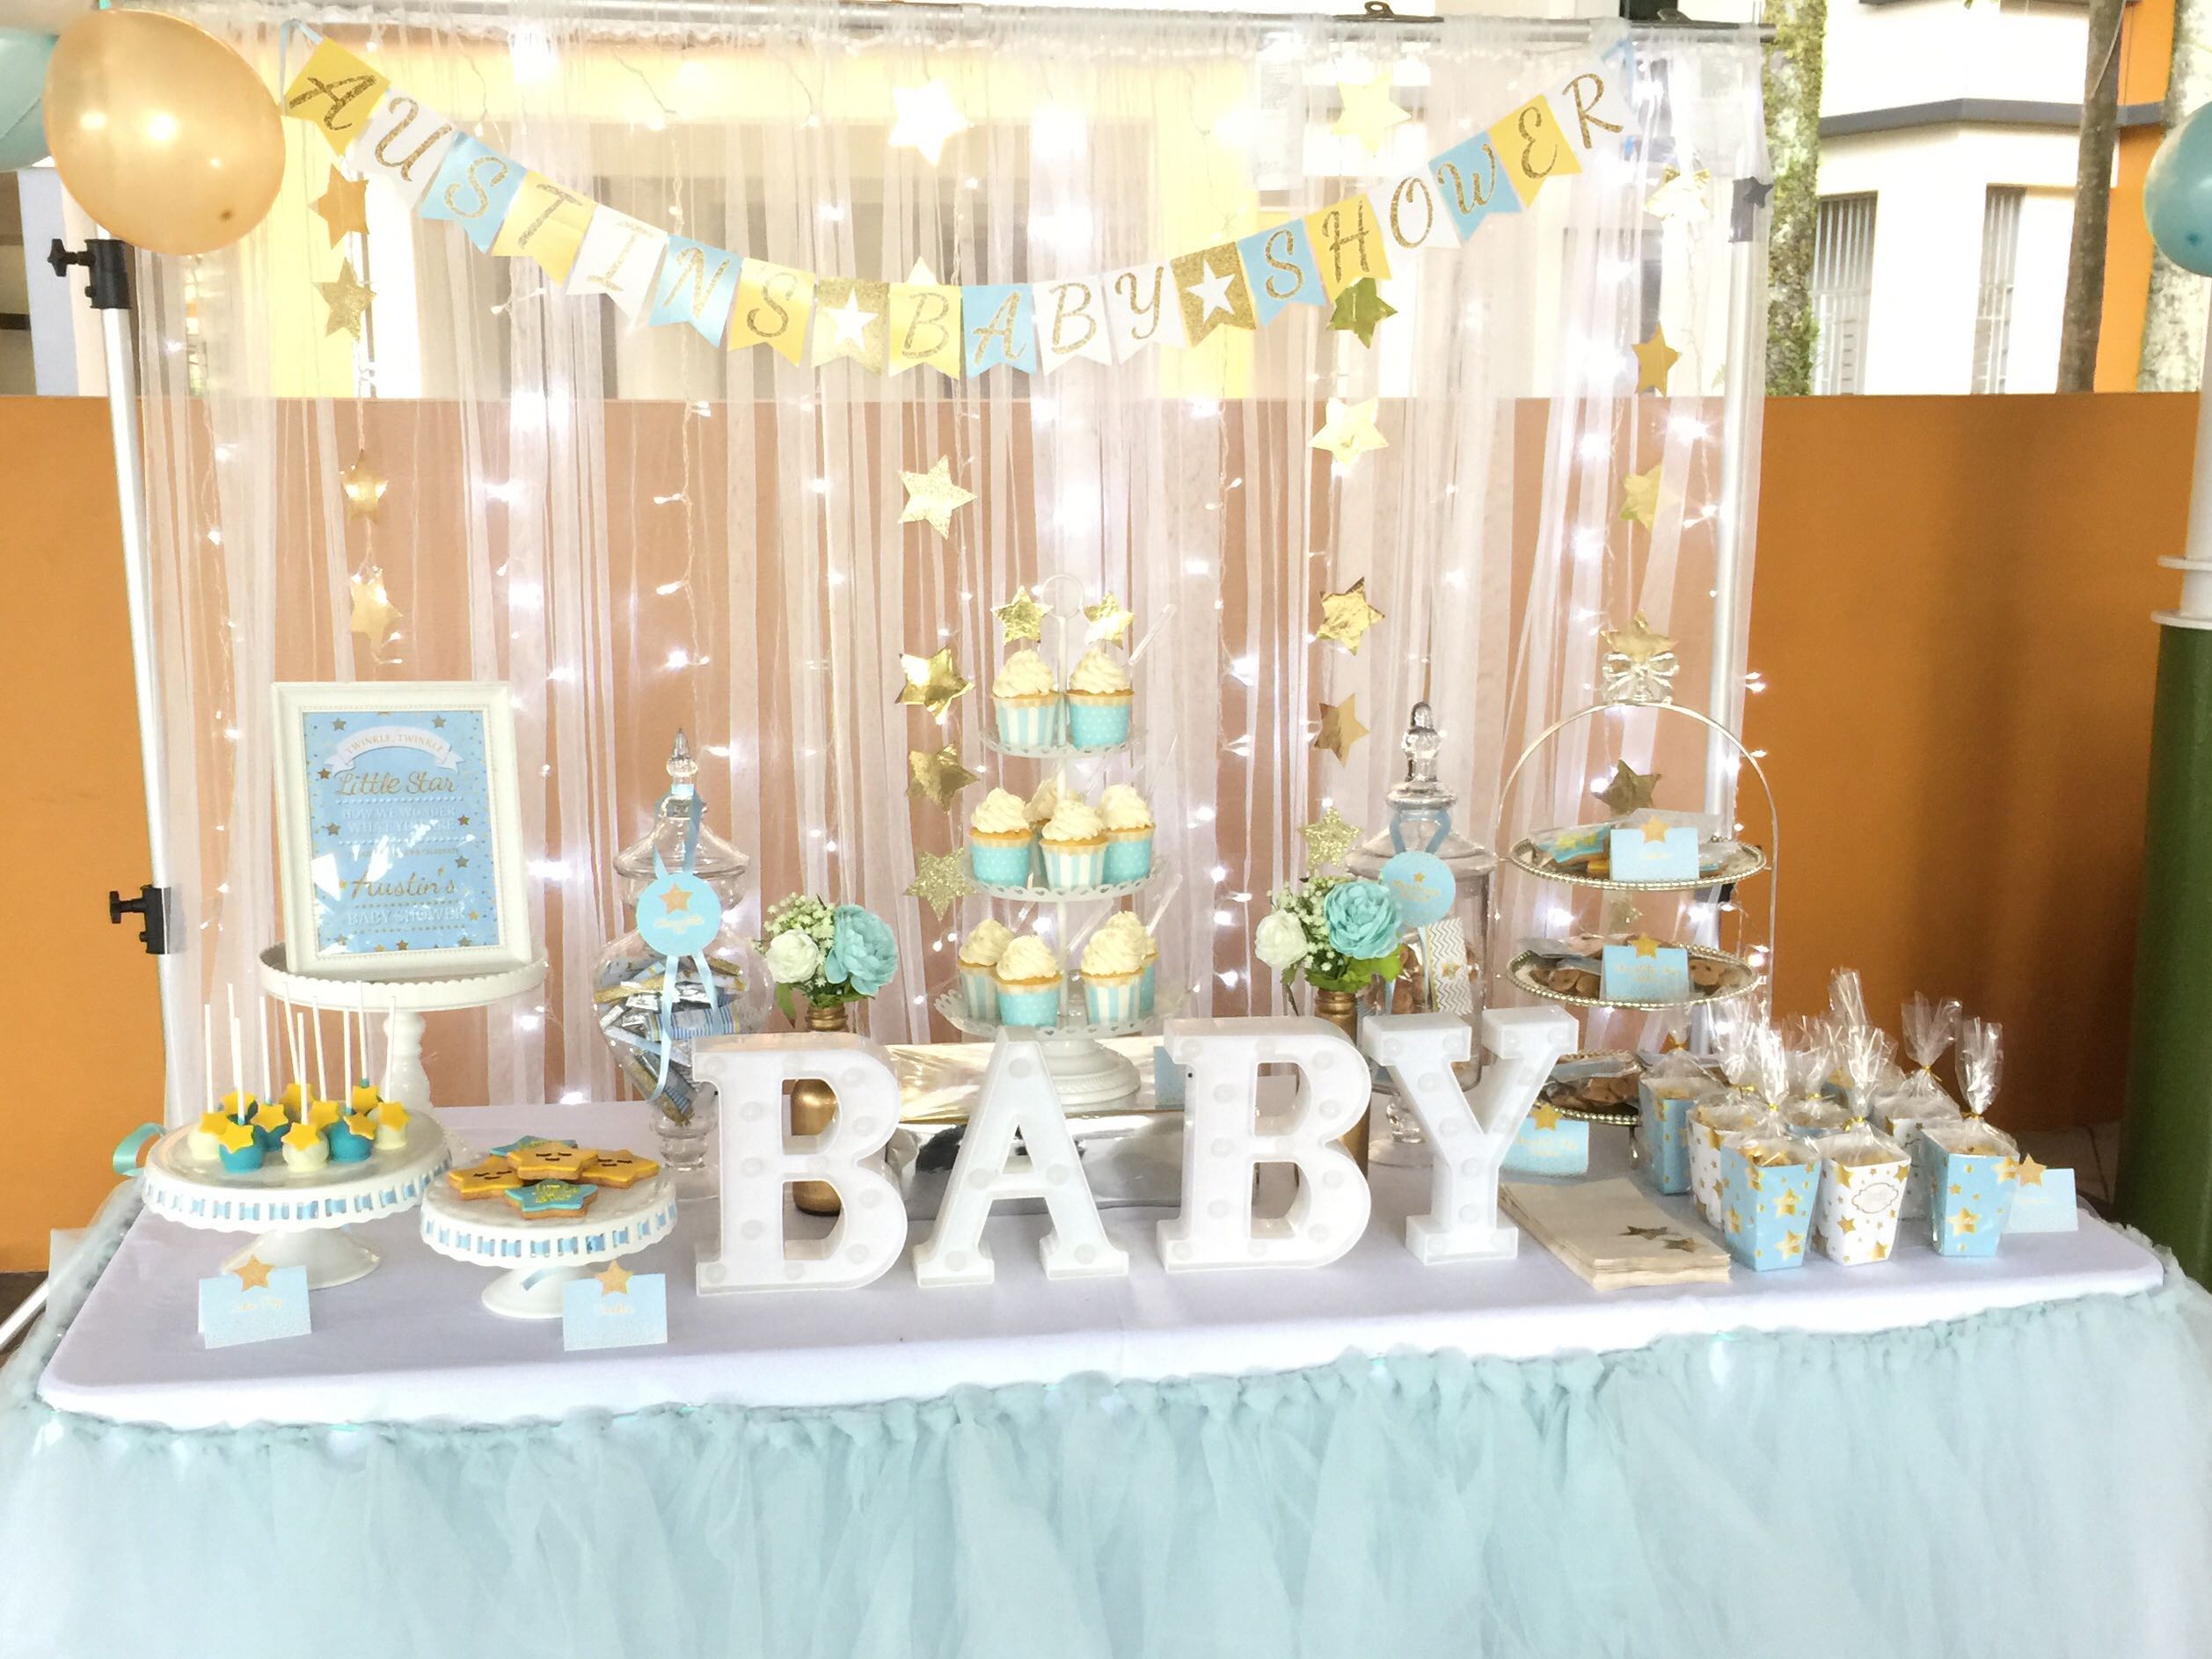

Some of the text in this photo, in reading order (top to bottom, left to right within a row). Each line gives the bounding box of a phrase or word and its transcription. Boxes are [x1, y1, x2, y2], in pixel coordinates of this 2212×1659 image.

[902, 264, 1165, 360] BABY
[1264, 72, 1624, 303] SHOWER
[336, 771, 456, 795] Little Star
[342, 808, 374, 820] HOW
[347, 906, 465, 926] BABY SHOWER
[693, 1005, 1579, 1296] BABY
